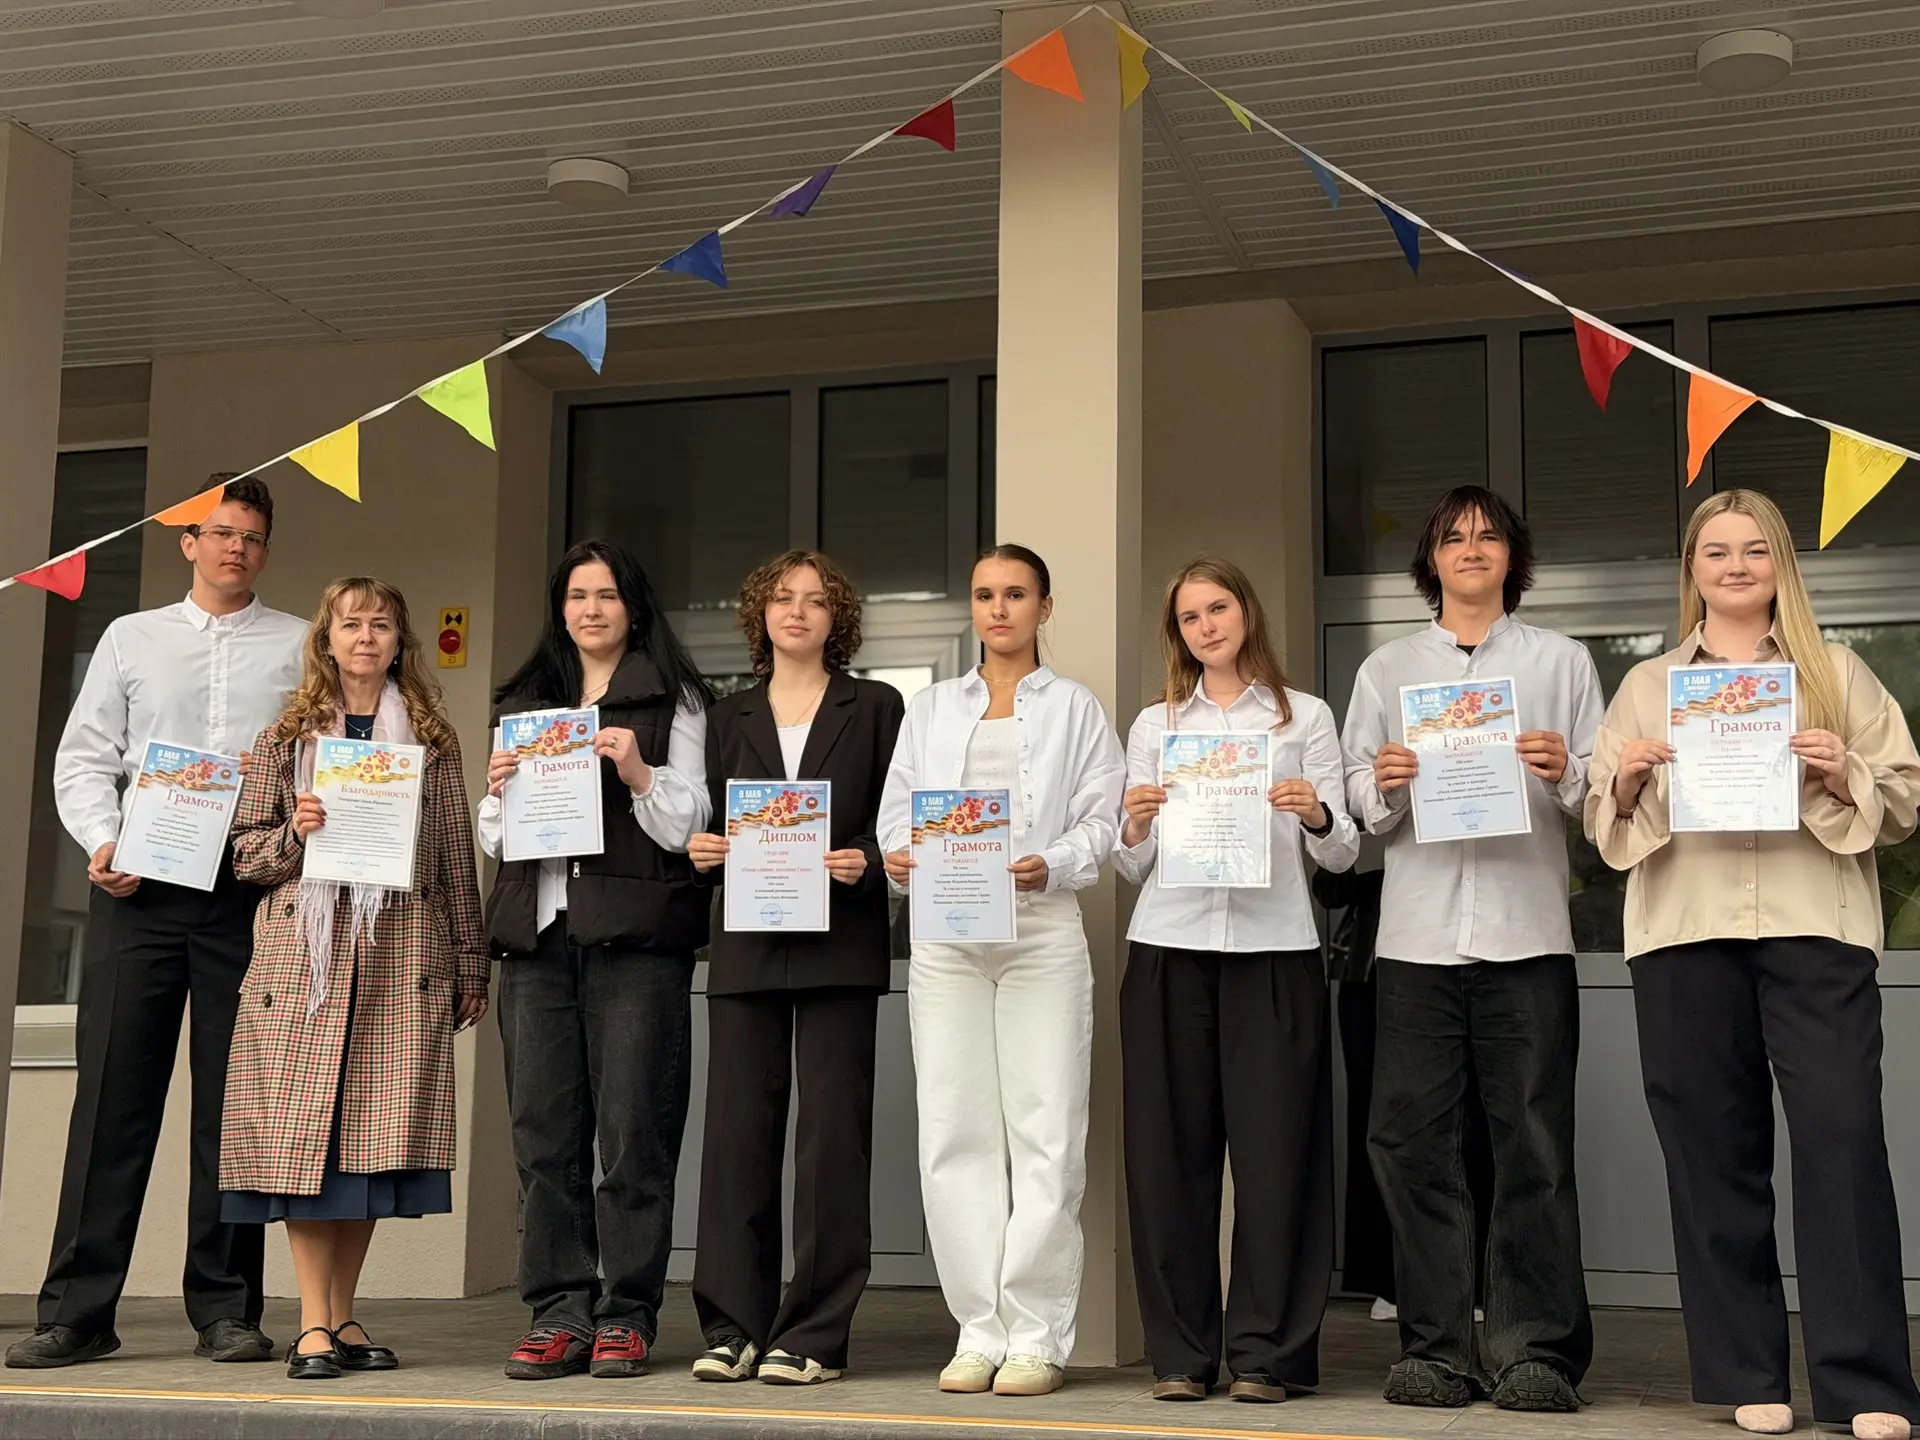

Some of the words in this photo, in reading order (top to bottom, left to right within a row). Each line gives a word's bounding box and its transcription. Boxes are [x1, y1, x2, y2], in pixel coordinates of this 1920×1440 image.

[1691, 675, 1710, 685] МАЯ
[1421, 693, 1440, 703] МАЯ
[1710, 719, 1782, 736] Грамота
[1443, 731, 1508, 750] Грамота
[164, 750, 180, 760] МАЯ
[533, 759, 590, 776] Грамота
[341, 784, 411, 799] Благодарность
[739, 790, 745, 798] 9
[746, 790, 761, 798] МАЯ
[1196, 782, 1258, 800] Грамота
[167, 788, 224, 811] Грамота
[922, 797, 927, 805] 9
[928, 797, 944, 805] МАЯ
[759, 830, 817, 844] Диплом
[943, 839, 1002, 855] Грамота
